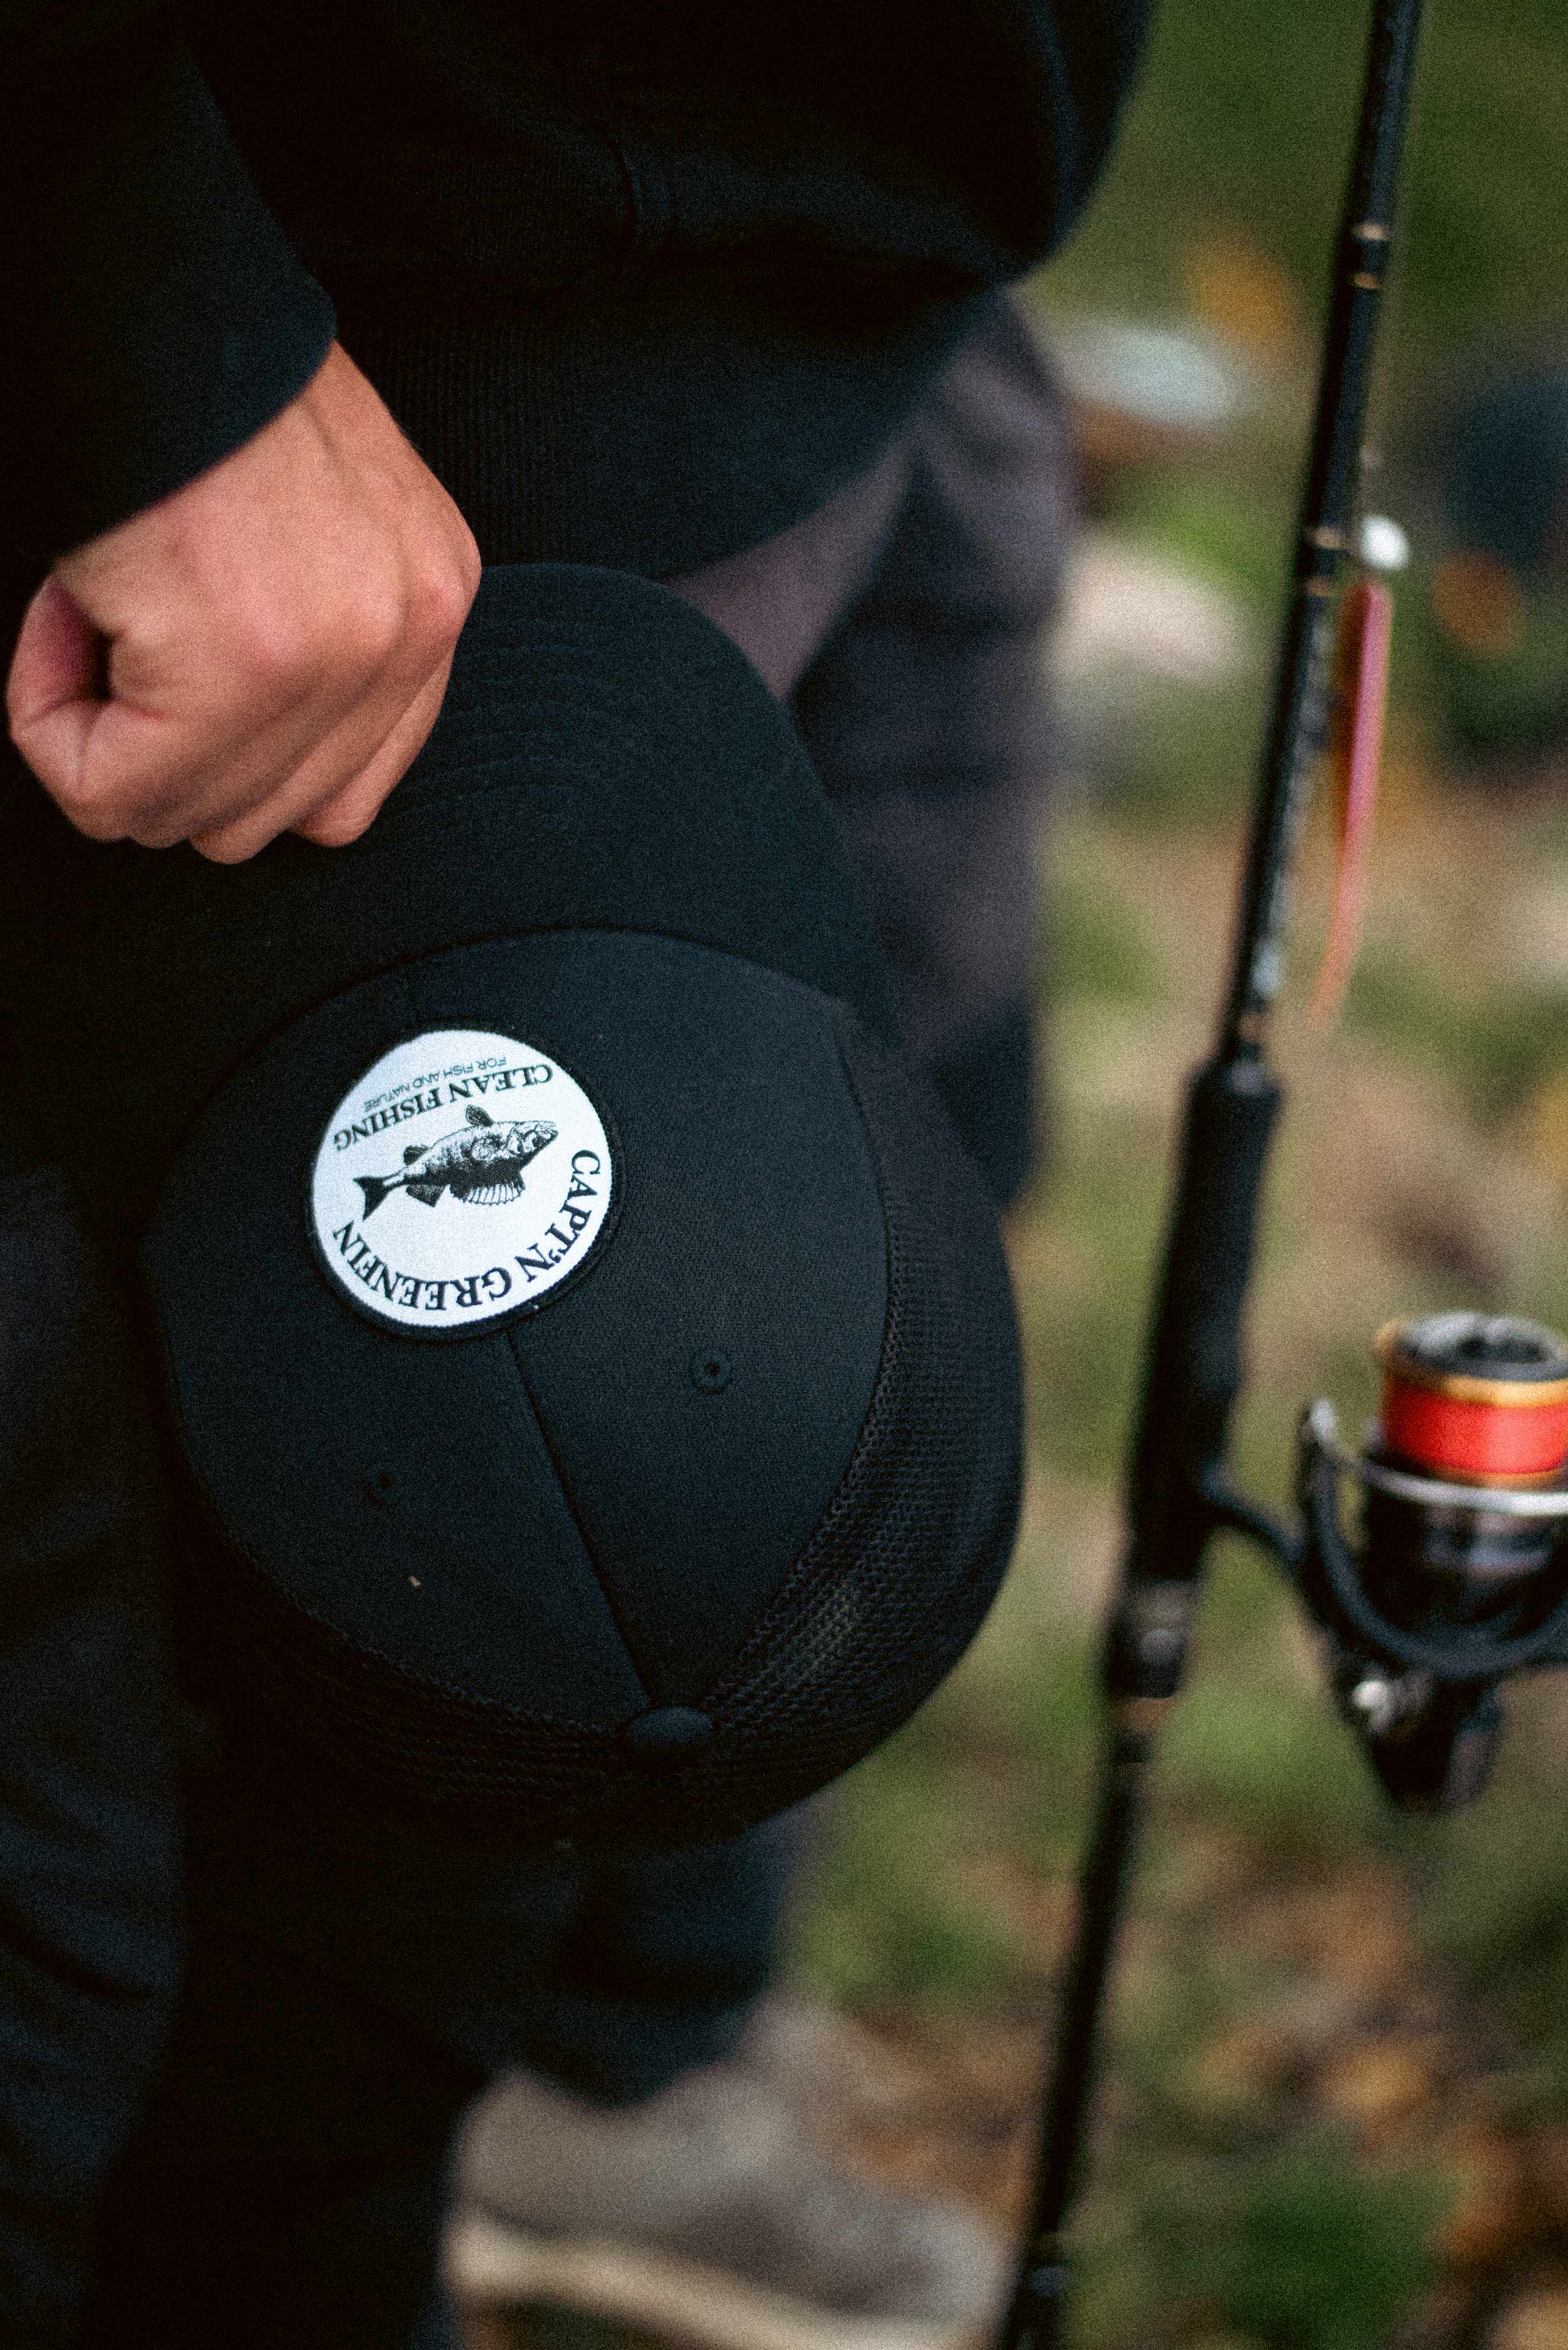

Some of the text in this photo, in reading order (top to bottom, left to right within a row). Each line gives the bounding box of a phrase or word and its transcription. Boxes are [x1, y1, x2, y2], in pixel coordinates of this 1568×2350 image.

[333, 1063, 554, 1151] CLEAN FISHING
[364, 1057, 508, 1112] FOR FISH AND NATURE
[333, 1149, 600, 1310] CAPT'N GREENFIN
